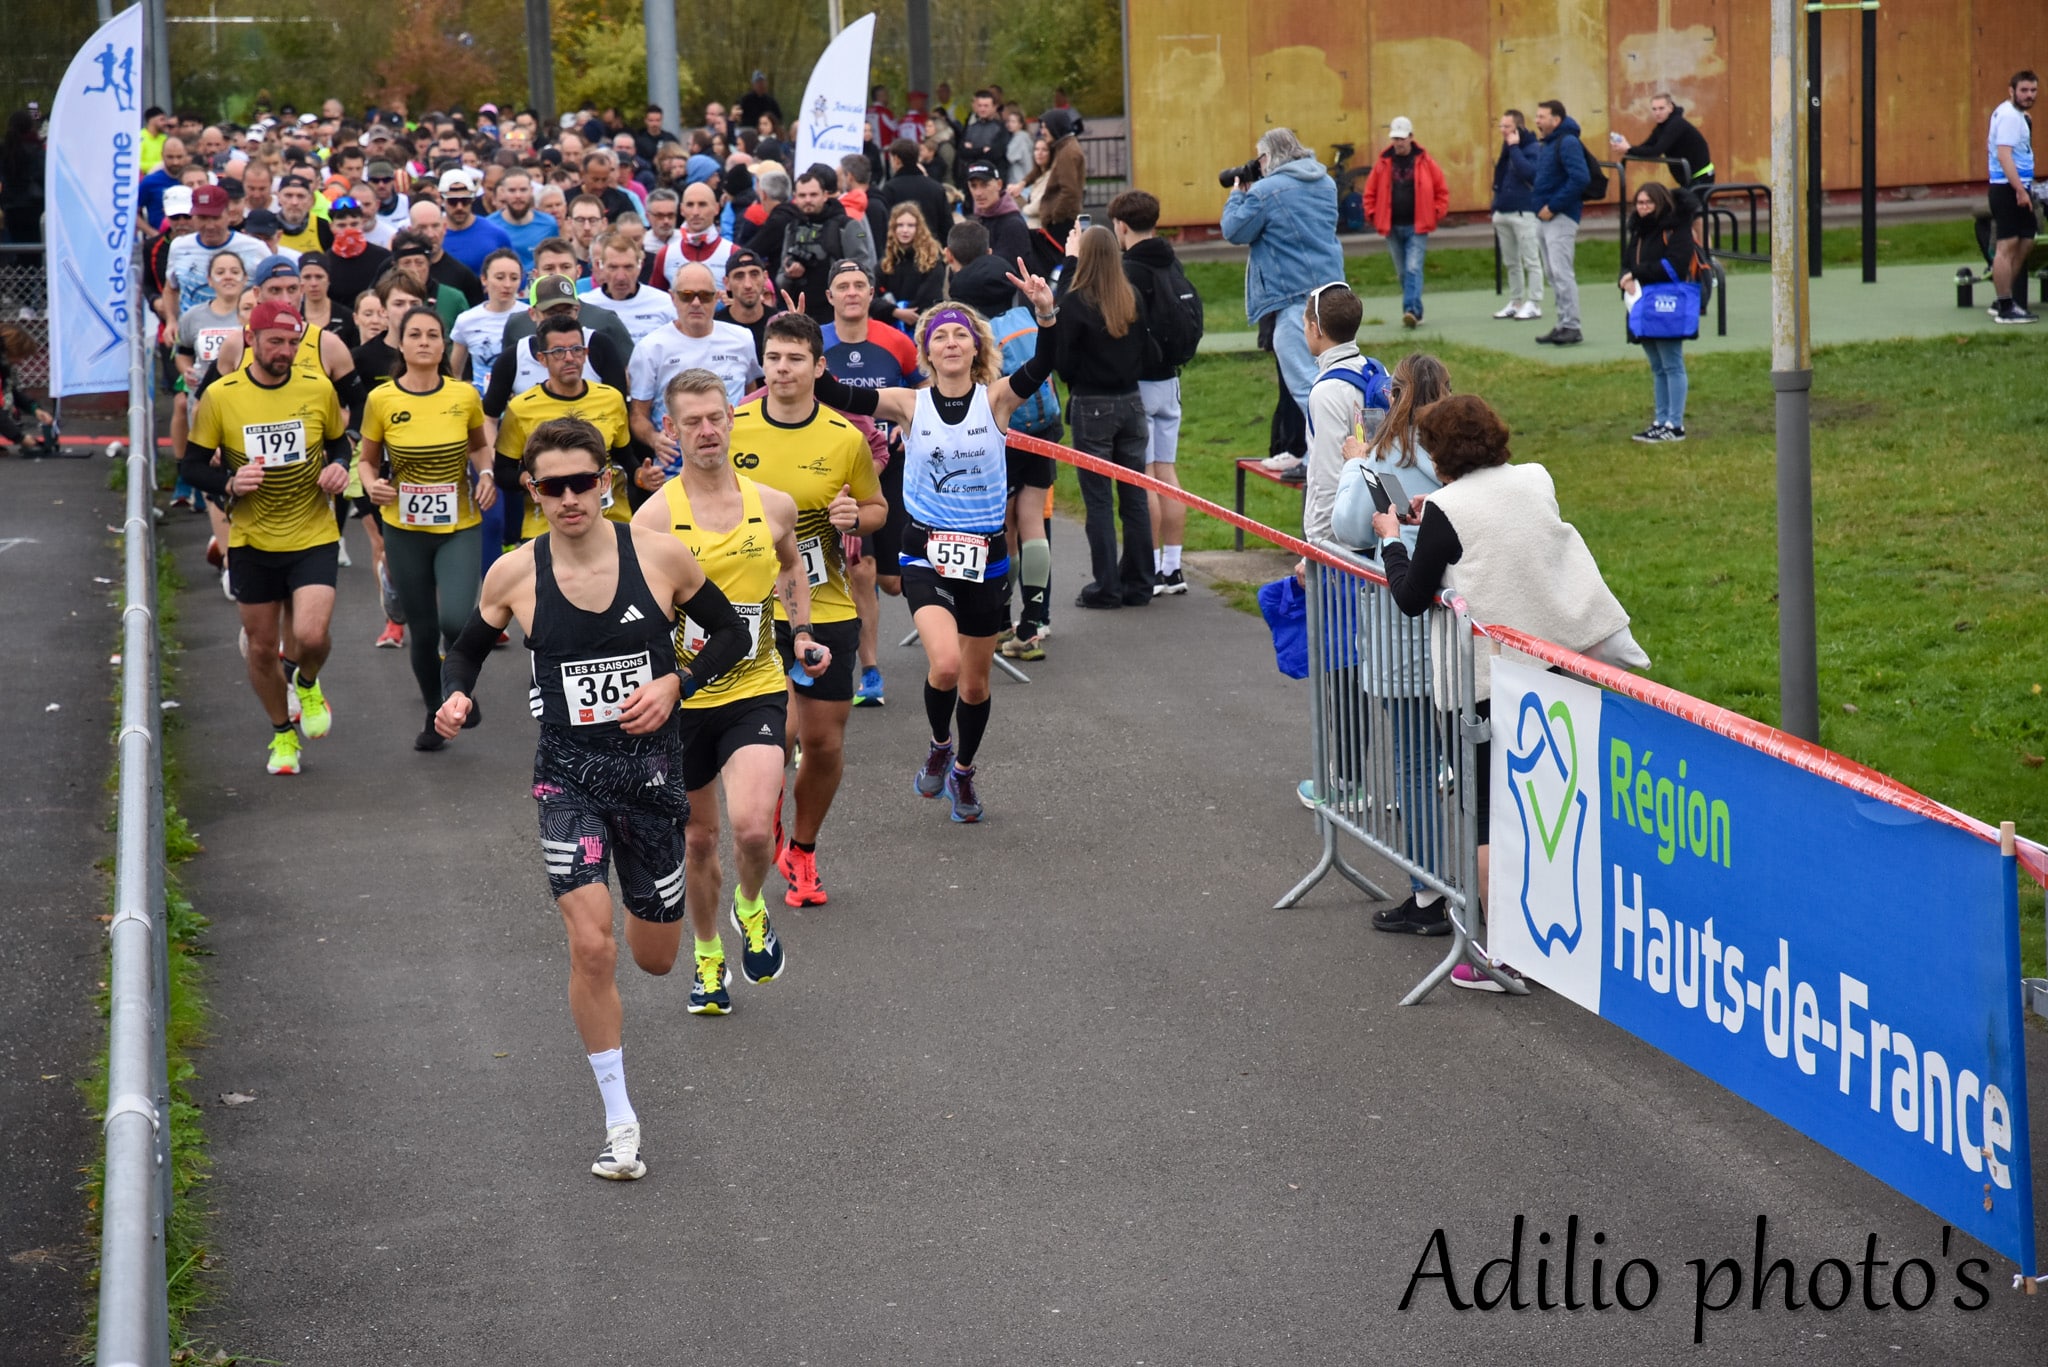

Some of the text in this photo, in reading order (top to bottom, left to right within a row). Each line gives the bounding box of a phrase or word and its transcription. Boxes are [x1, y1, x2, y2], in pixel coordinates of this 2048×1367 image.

[108, 131, 132, 251] Somme
[109, 257, 127, 293] de
[838, 377, 887, 388] ERONNE
[967, 426, 988, 436] KARINE
[256, 431, 296, 454] 199
[952, 447, 986, 460] Amicale
[970, 465, 982, 474] du
[951, 484, 961, 493] de
[963, 485, 987, 493] Somme
[408, 494, 447, 513] 625
[955, 535, 985, 545] SAISONS
[937, 543, 978, 568] 551
[569, 658, 644, 675] LES 4 SAISONS
[577, 670, 640, 707] 365
[1610, 737, 1731, 868] Région
[1614, 864, 2012, 1190] Hauts-de-France
